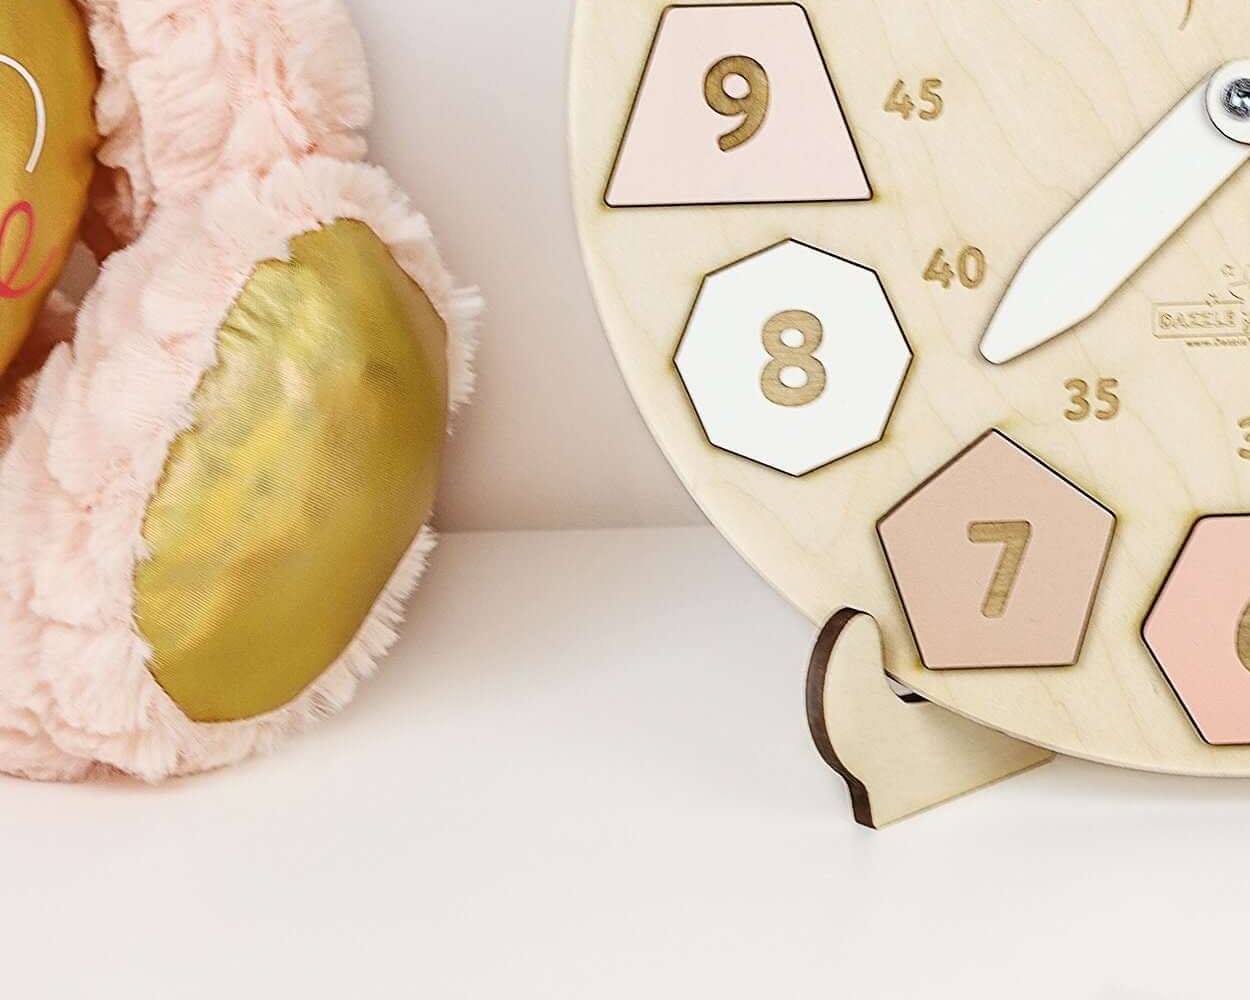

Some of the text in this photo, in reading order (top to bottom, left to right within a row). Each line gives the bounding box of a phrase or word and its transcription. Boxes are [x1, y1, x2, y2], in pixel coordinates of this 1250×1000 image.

[702, 55, 770, 152] 9
[884, 77, 943, 120] 45
[922, 245, 987, 289] 40
[1158, 311, 1236, 330] DAZZLE
[759, 309, 827, 408] 8
[1064, 377, 1120, 421] 35
[968, 520, 1032, 617] 7
